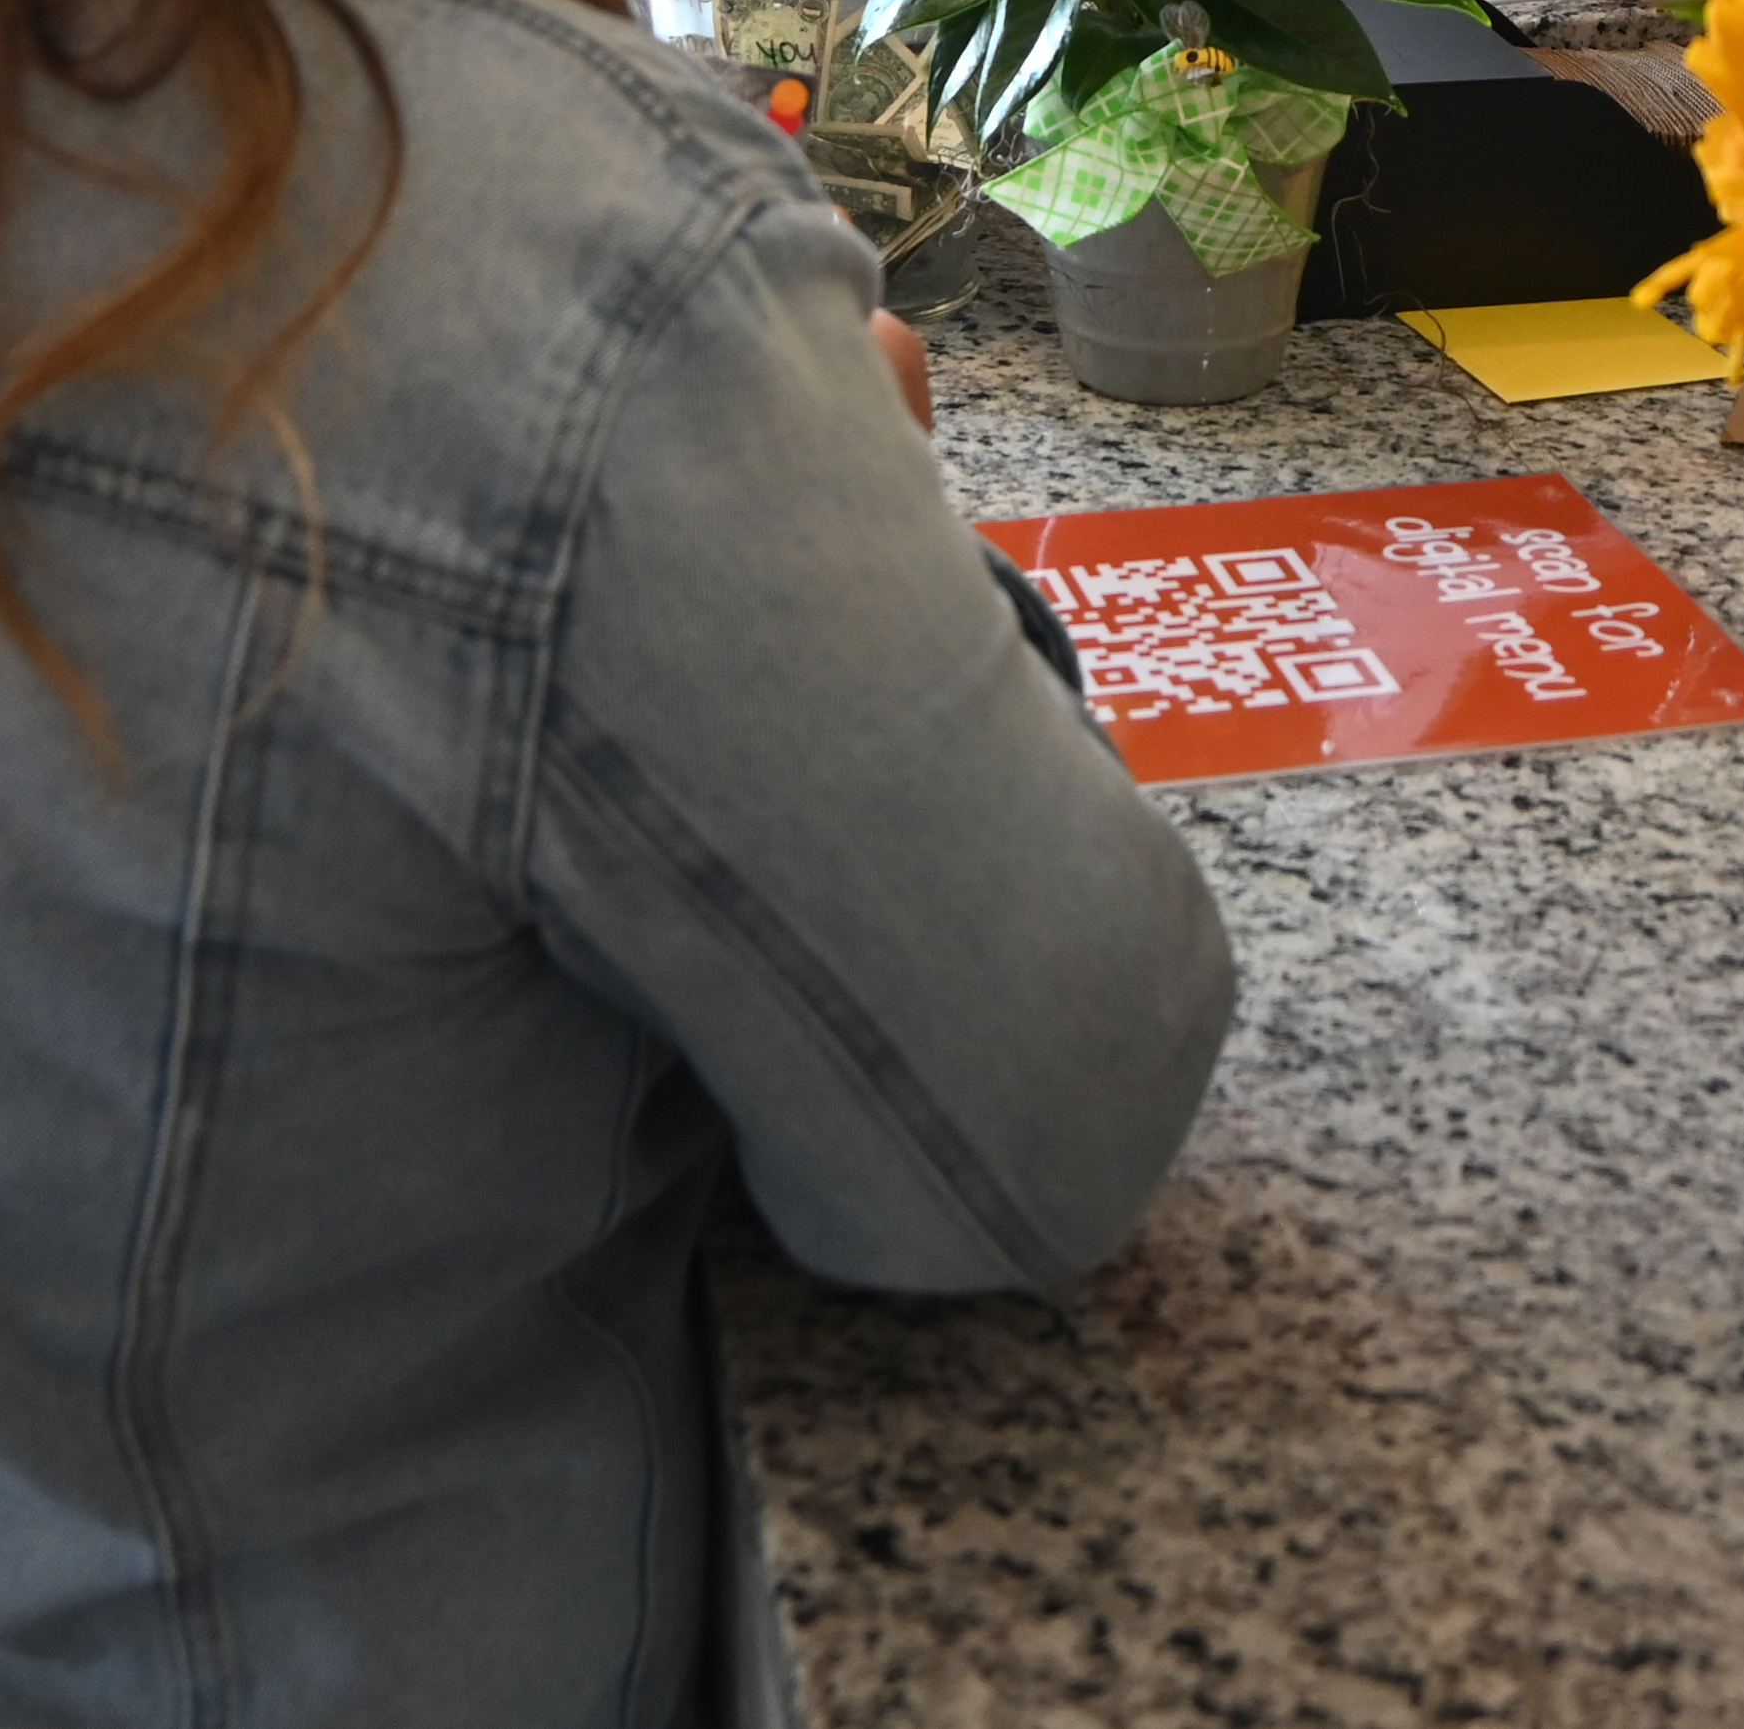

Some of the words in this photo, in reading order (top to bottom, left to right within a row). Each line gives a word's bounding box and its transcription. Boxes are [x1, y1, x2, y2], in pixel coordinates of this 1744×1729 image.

[1382, 516, 1523, 603] digital
[1464, 611, 1589, 701] menu
[1500, 528, 1602, 593] scan
[1571, 601, 1665, 658] for
